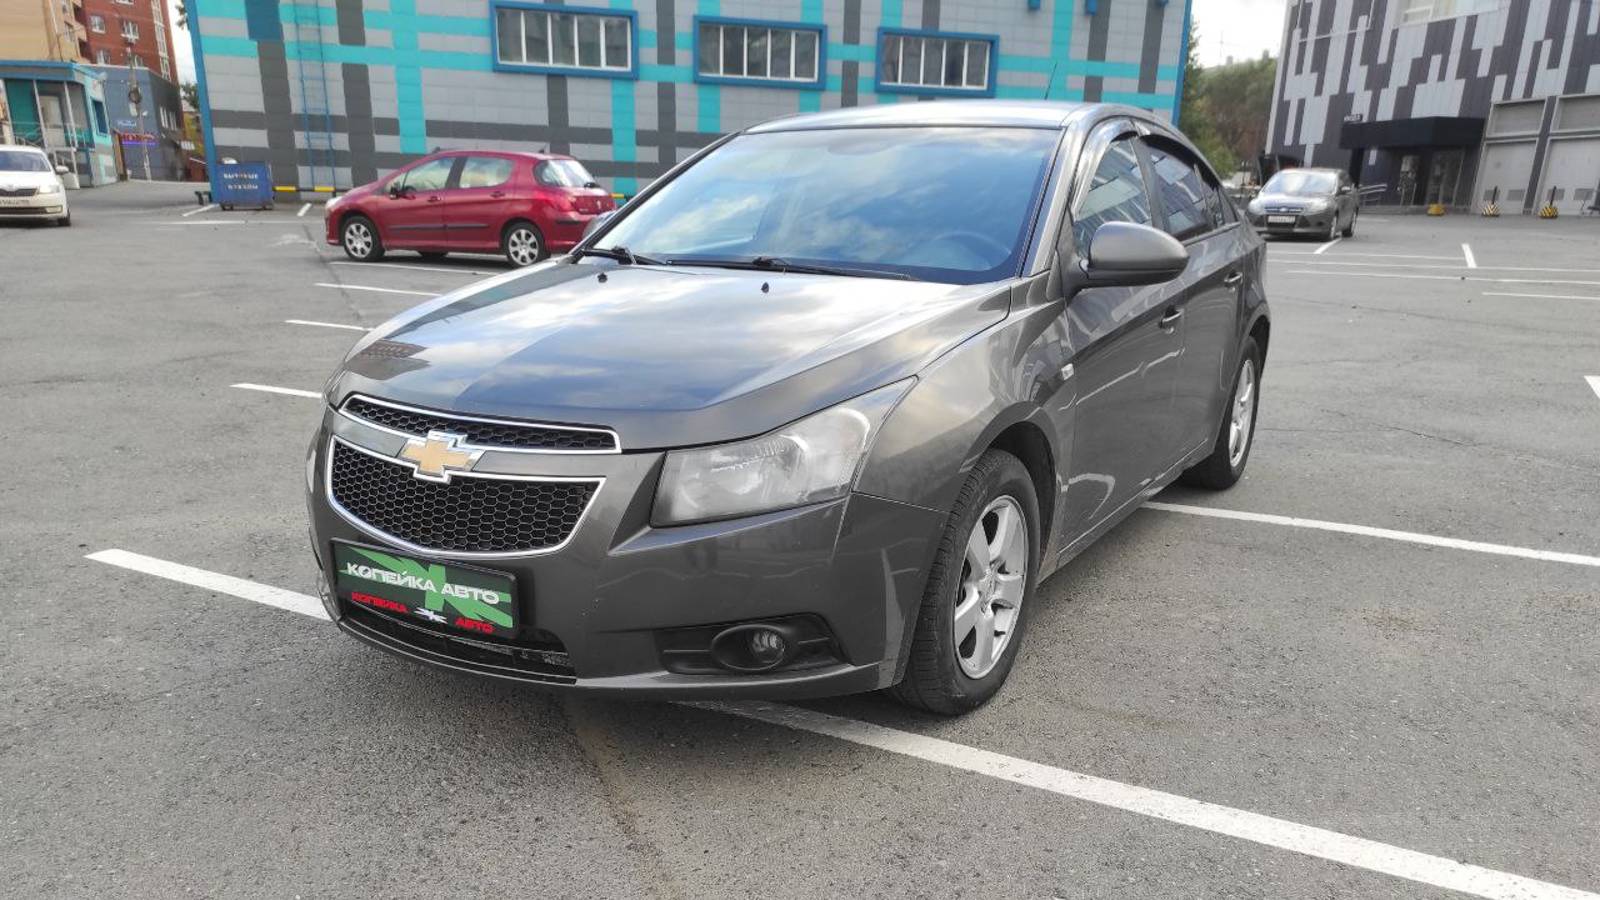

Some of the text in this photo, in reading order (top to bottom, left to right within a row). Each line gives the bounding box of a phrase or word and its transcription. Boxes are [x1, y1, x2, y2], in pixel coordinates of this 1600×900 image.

[347, 562, 500, 605] КОПЕЙКА АВТО
[455, 617, 495, 634] АВТО
